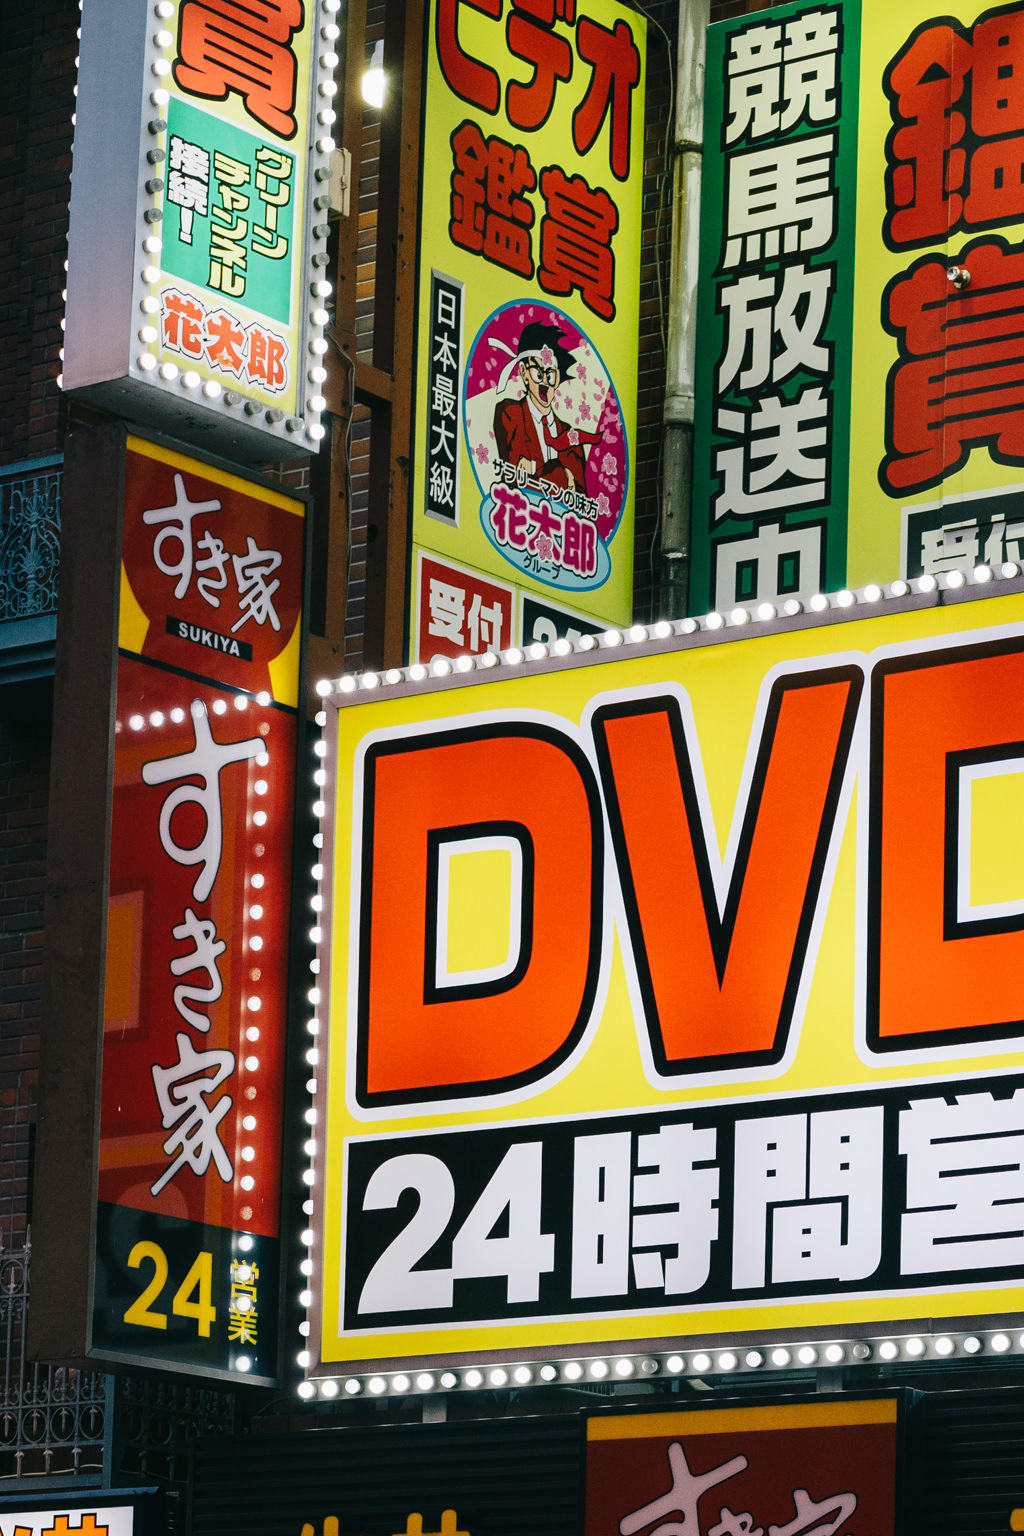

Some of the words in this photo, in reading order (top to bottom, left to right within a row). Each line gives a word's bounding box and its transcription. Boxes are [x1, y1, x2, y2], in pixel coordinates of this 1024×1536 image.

[167, 135, 211, 244] 接続!
[209, 151, 251, 298] チャンネル
[253, 145, 292, 259] グリーン
[447, 118, 620, 322] 鑑賞
[161, 289, 288, 392] 花太郎
[717, 4, 843, 612] 競馬放送中
[430, 286, 459, 507] 日本最大級
[487, 482, 600, 579] 花太郎
[491, 457, 600, 520] サラリーマンの味方
[142, 472, 283, 634] すき家
[523, 555, 563, 580] グループ
[178, 621, 240, 657] SUKIYA
[428, 577, 504, 651] 受付
[141, 696, 267, 1197] すき家
[123, 1239, 217, 1338] 24
